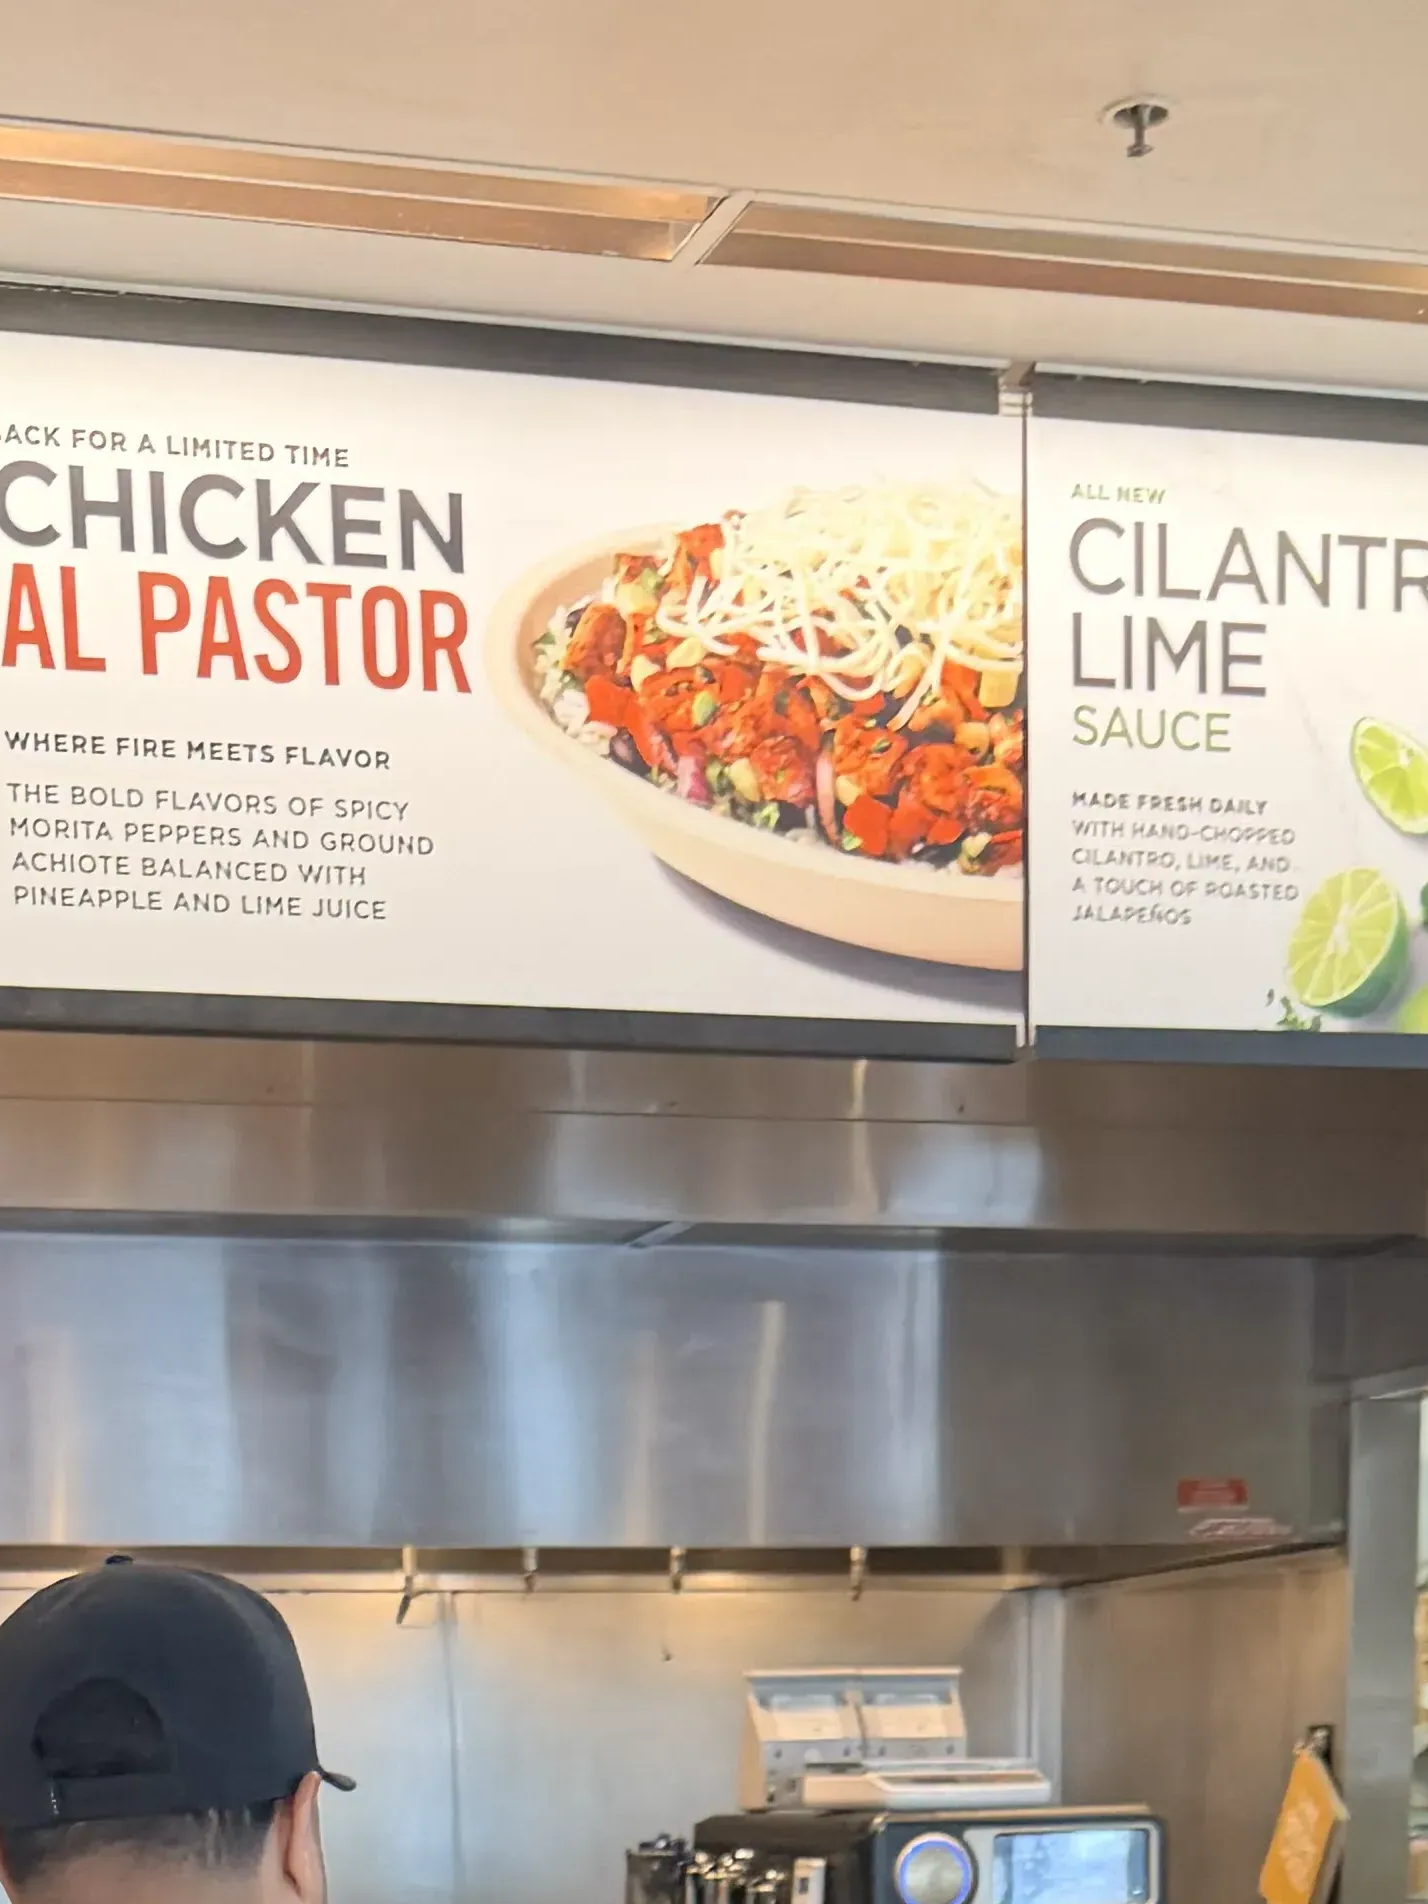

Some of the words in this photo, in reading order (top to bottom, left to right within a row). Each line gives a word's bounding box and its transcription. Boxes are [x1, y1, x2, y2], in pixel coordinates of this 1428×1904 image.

[72, 430, 127, 452] FOR
[137, 434, 156, 454] A
[167, 436, 274, 462] LIMITED
[285, 445, 350, 468] TIME
[1071, 483, 1110, 501] ALL
[1117, 487, 1166, 505] NEW
[1, 562, 106, 672] AL
[138, 571, 473, 694] PASTOR
[1072, 612, 1268, 697] LIME
[1072, 704, 1233, 753] SAUCE
[5, 731, 106, 755] WHERE
[117, 738, 176, 758] FIRE
[187, 741, 274, 764] MEETS
[285, 745, 391, 770] FLAVOR
[7, 783, 60, 805] THE
[70, 785, 144, 809] BOLD
[155, 790, 278, 815] FLAVORS
[288, 796, 326, 817] OF
[334, 798, 411, 822] SPICY
[1072, 792, 1130, 809] MADE
[1137, 794, 1203, 812] FRESH
[1209, 798, 1268, 815] DAILY
[10, 817, 113, 841] MORITA
[124, 823, 242, 848] PEPPERS
[253, 828, 311, 851] AND
[321, 831, 434, 856] GROUND
[1072, 820, 1125, 837] WITH
[1132, 822, 1296, 845] HAND-CHOPPED
[12, 852, 131, 876] ACHIOTE
[141, 858, 288, 883] BALANCED
[298, 863, 367, 886] WITH
[1072, 848, 1180, 871] CILANTRO,
[1187, 853, 1239, 873] LIME,
[1246, 856, 1290, 873] AND
[14, 886, 163, 912] PINEAPPLE
[173, 892, 231, 914] AND
[241, 894, 302, 917] LIME
[312, 897, 387, 921] JUICE
[1072, 877, 1085, 892] A
[1094, 878, 1163, 896] TOUCH
[1170, 881, 1199, 898] OF
[1205, 882, 1299, 901] ROASTED
